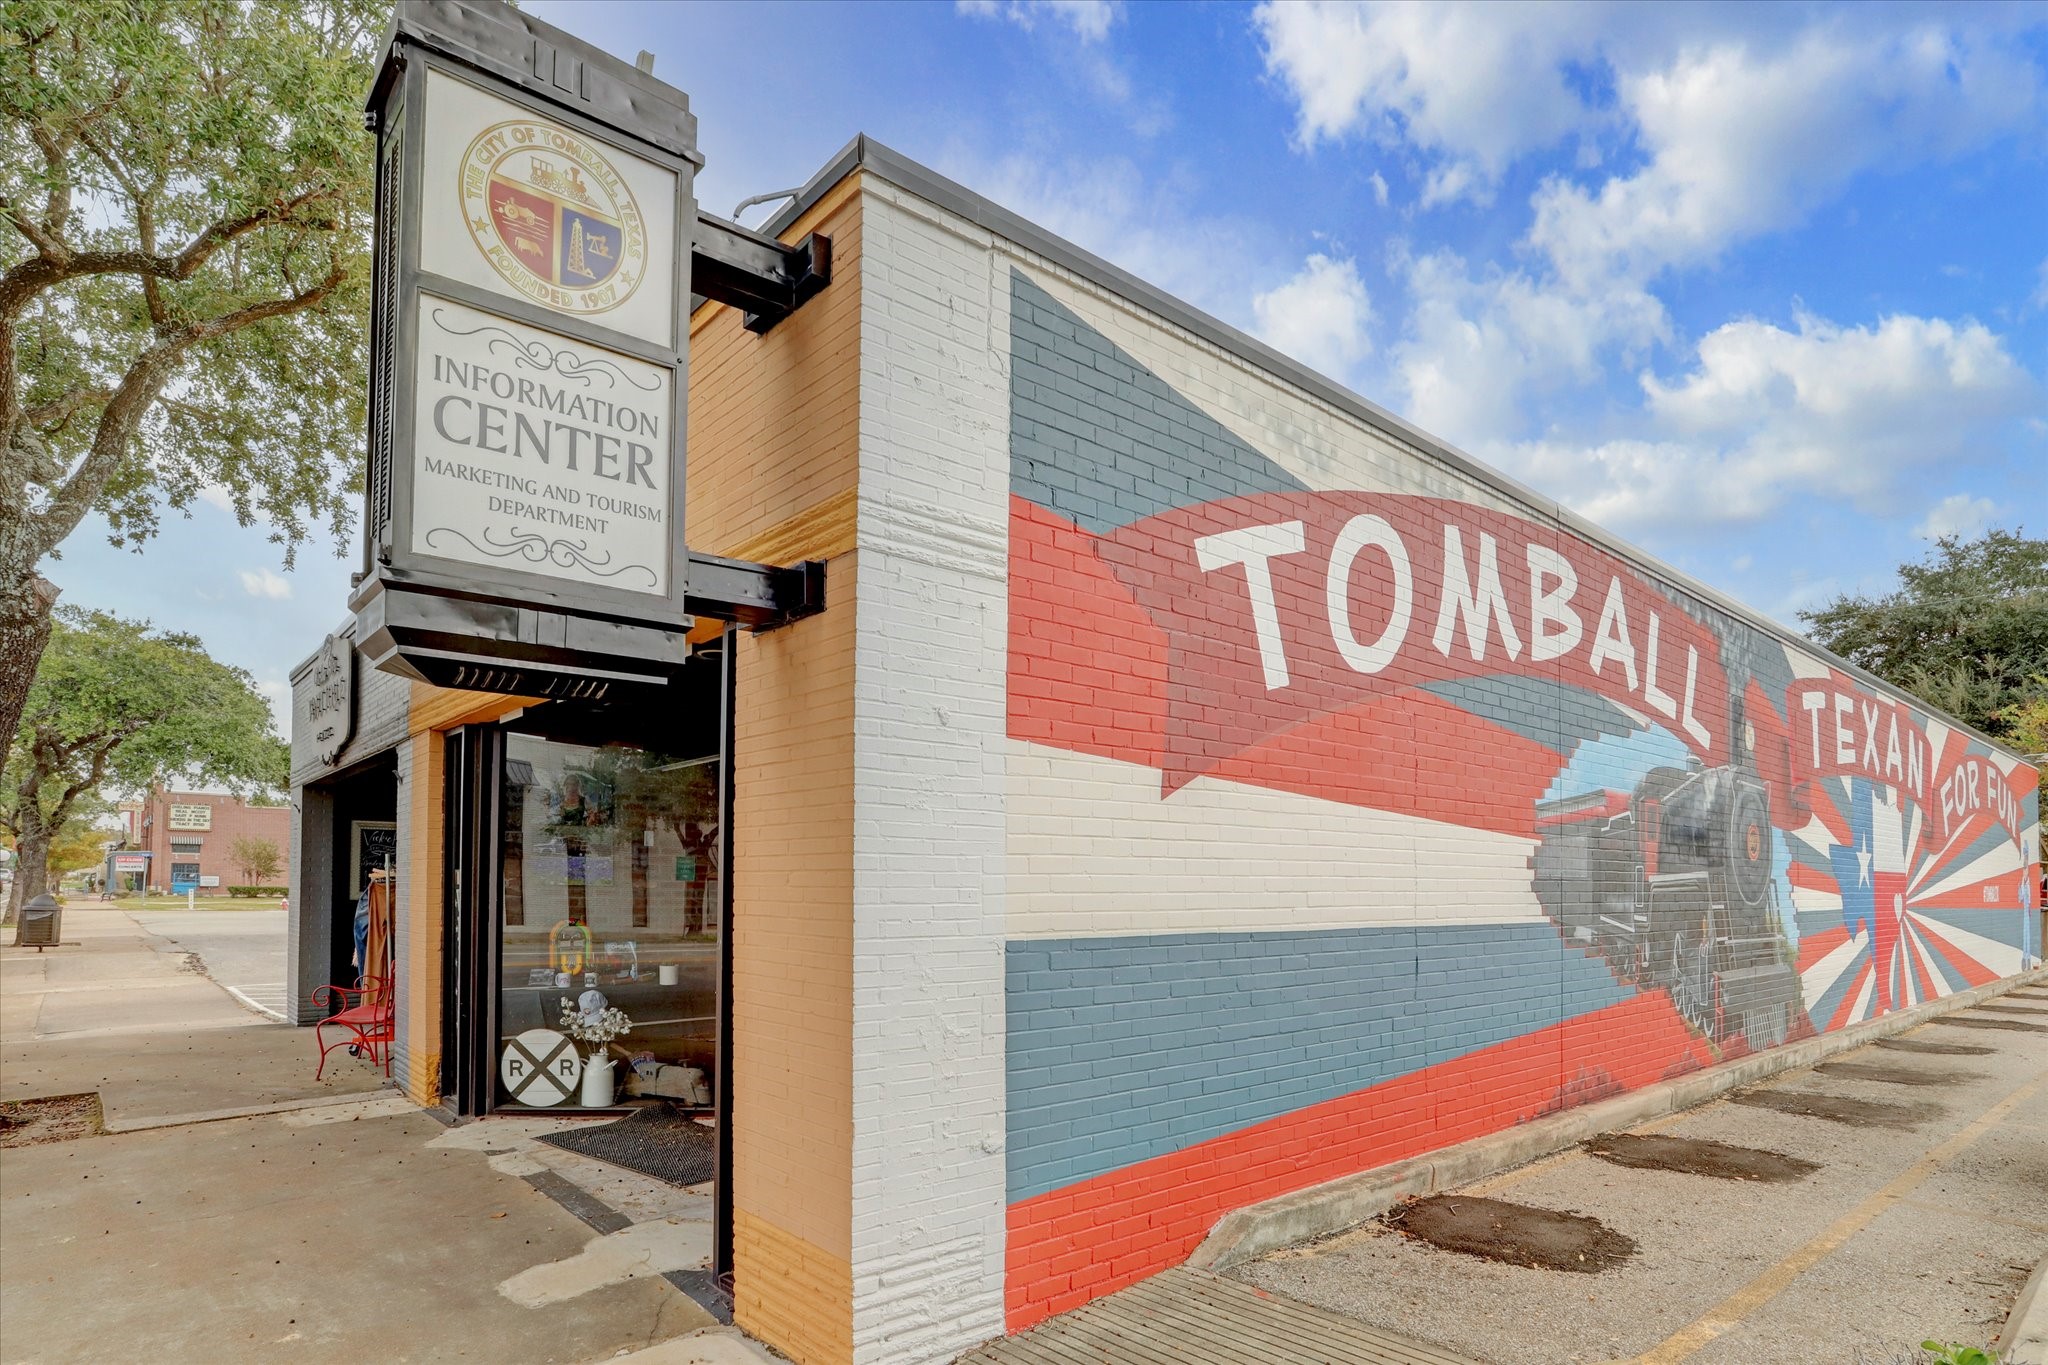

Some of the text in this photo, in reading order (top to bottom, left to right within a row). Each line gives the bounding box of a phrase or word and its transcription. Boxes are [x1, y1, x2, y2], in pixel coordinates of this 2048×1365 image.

[466, 127, 642, 259] THE CITY OF TOMBALL, TEXAS
[488, 244, 616, 309] FOUNDED 1907
[433, 354, 659, 440] INFORMATION
[433, 395, 658, 490] CENTER
[424, 456, 662, 523] MARKETING AND TOURISM
[488, 496, 609, 534] DEPARTMENT
[1194, 513, 1711, 751] TOMBALL
[1802, 691, 1923, 799] TEXAN
[1940, 760, 2017, 838] FOR FUN
[509, 1059, 574, 1077] R R
